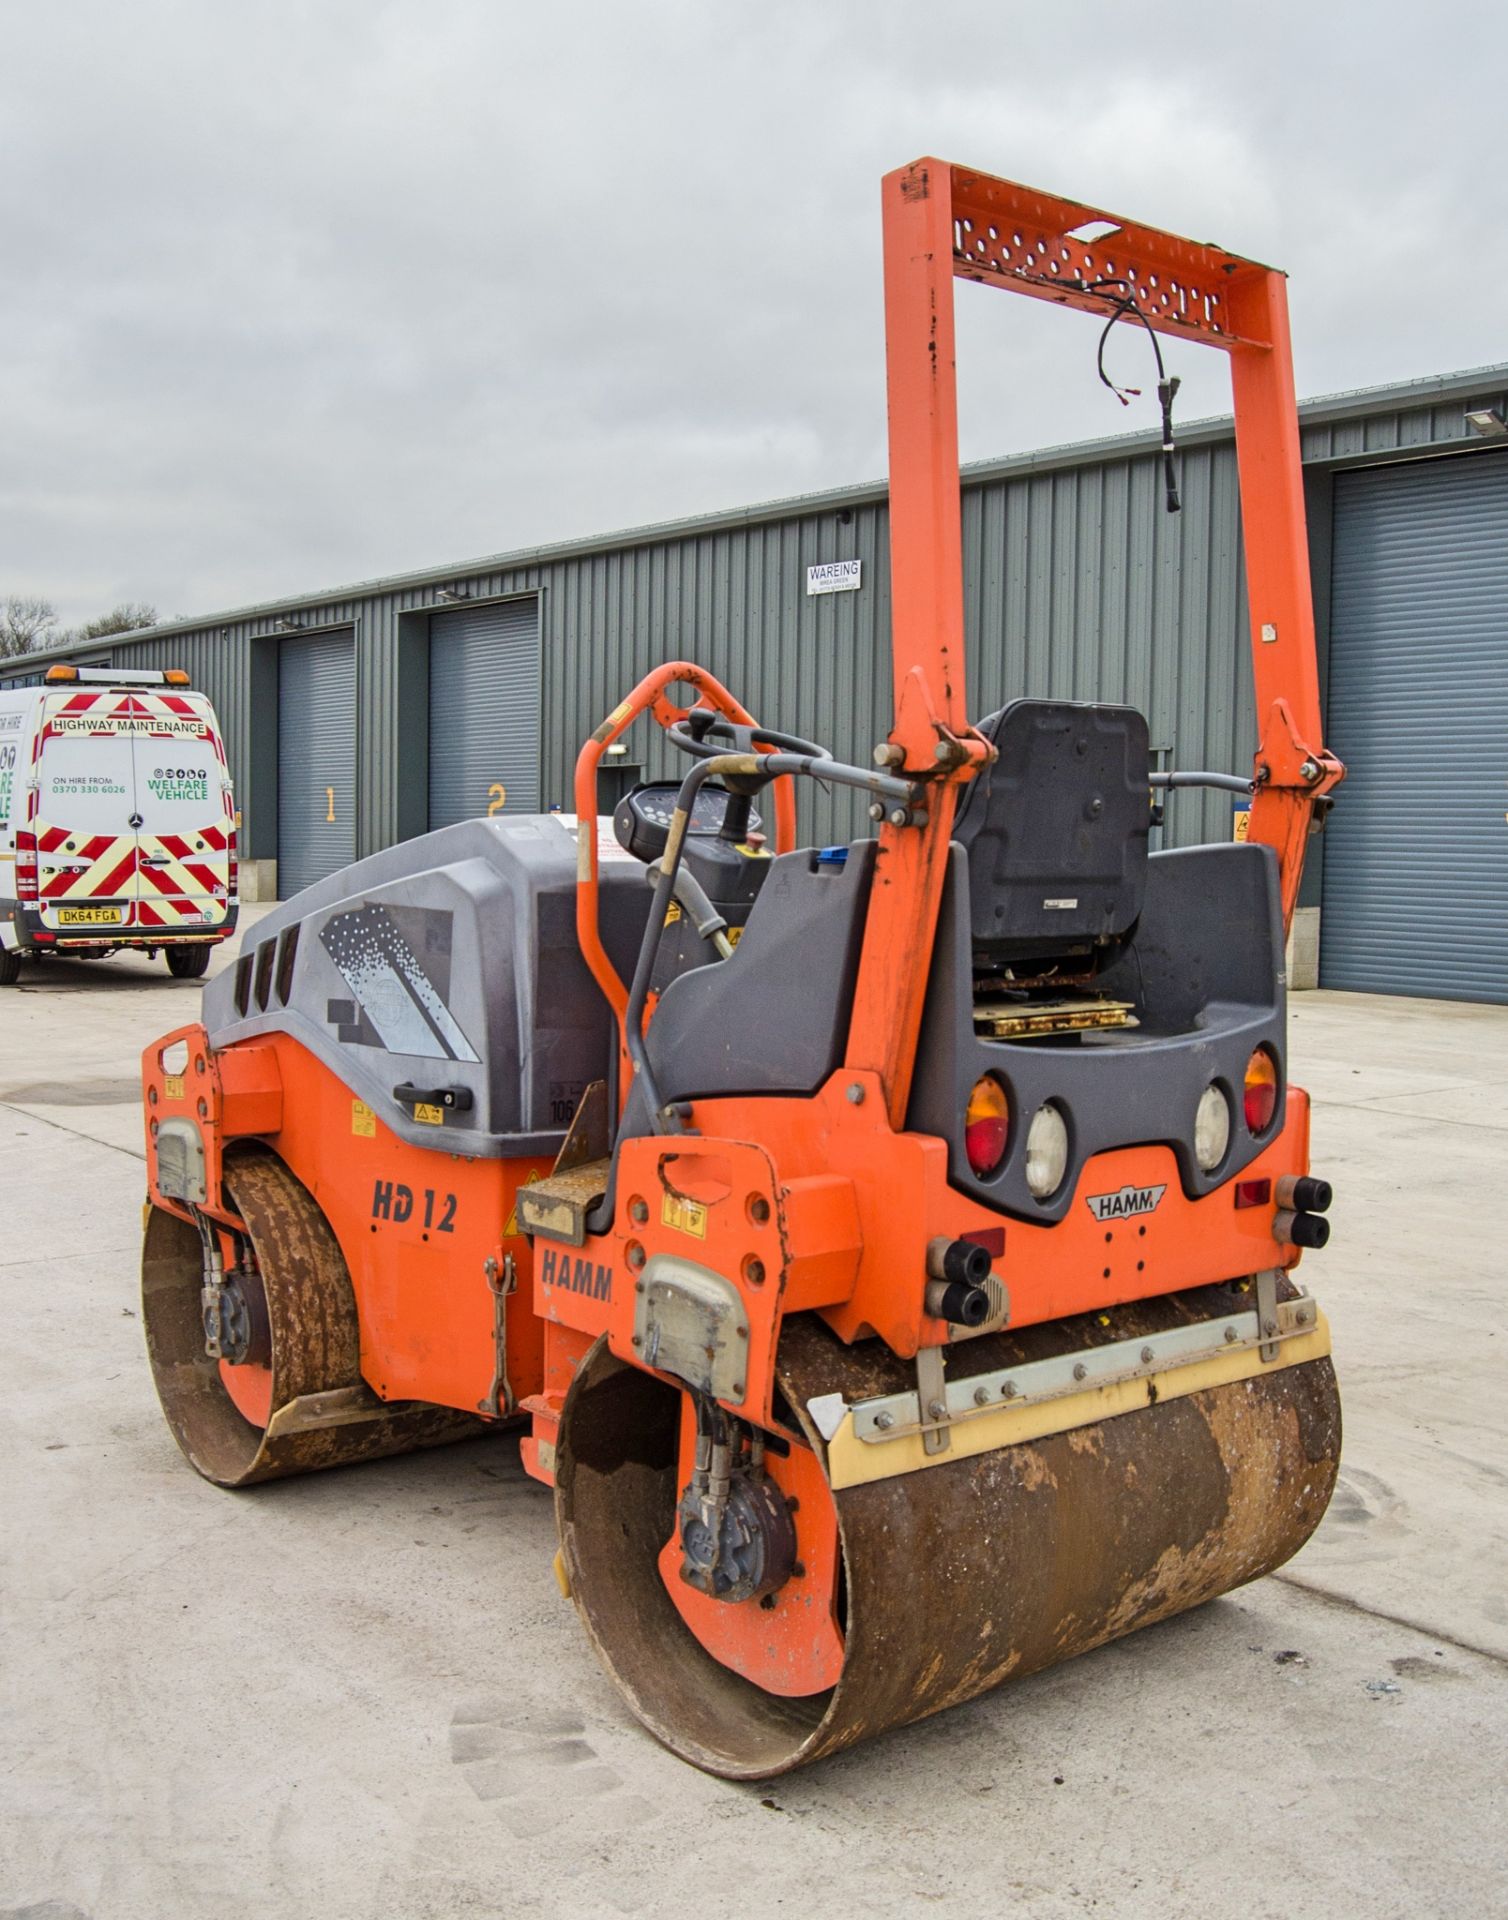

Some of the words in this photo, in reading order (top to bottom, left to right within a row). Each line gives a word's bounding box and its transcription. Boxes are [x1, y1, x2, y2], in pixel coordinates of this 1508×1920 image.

[810, 562, 858, 580] WAREING
[54, 720, 113, 730] HIGHWAY
[117, 720, 205, 733] MAINTENANCE
[148, 780, 207, 790] WELFARE
[156, 790, 208, 800] VEHICLE
[326, 787, 335, 822] 1
[64, 910, 92, 921] DK64
[96, 910, 117, 921] FGA
[551, 1100, 575, 1123] 106
[372, 1179, 413, 1223] HD
[424, 1189, 457, 1233] 12
[1099, 1190, 1153, 1217] HAMM
[542, 1249, 612, 1303] HAMM
